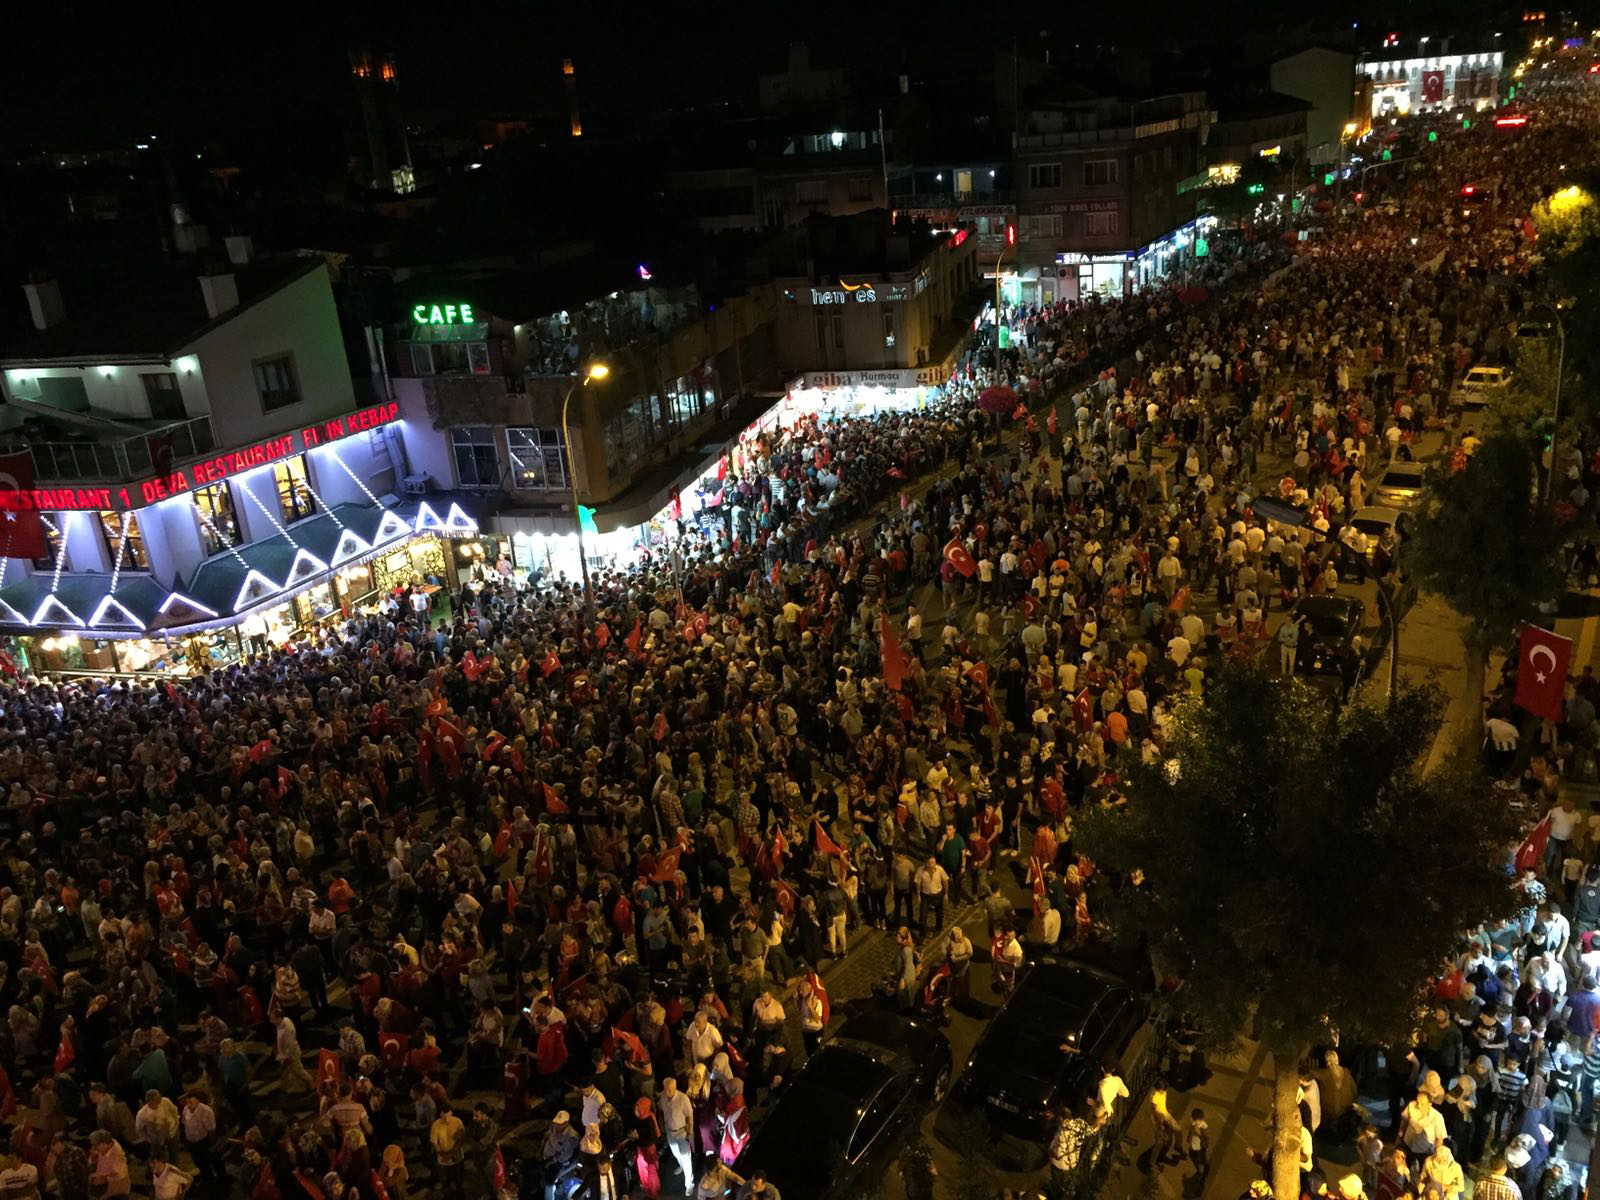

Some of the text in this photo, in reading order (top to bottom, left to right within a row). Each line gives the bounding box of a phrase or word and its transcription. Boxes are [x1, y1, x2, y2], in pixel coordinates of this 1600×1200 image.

[413, 304, 474, 324] CAFE
[193, 435, 293, 484] RESTAURANT
[346, 402, 399, 432] KEBAP
[118, 487, 131, 509] 1
